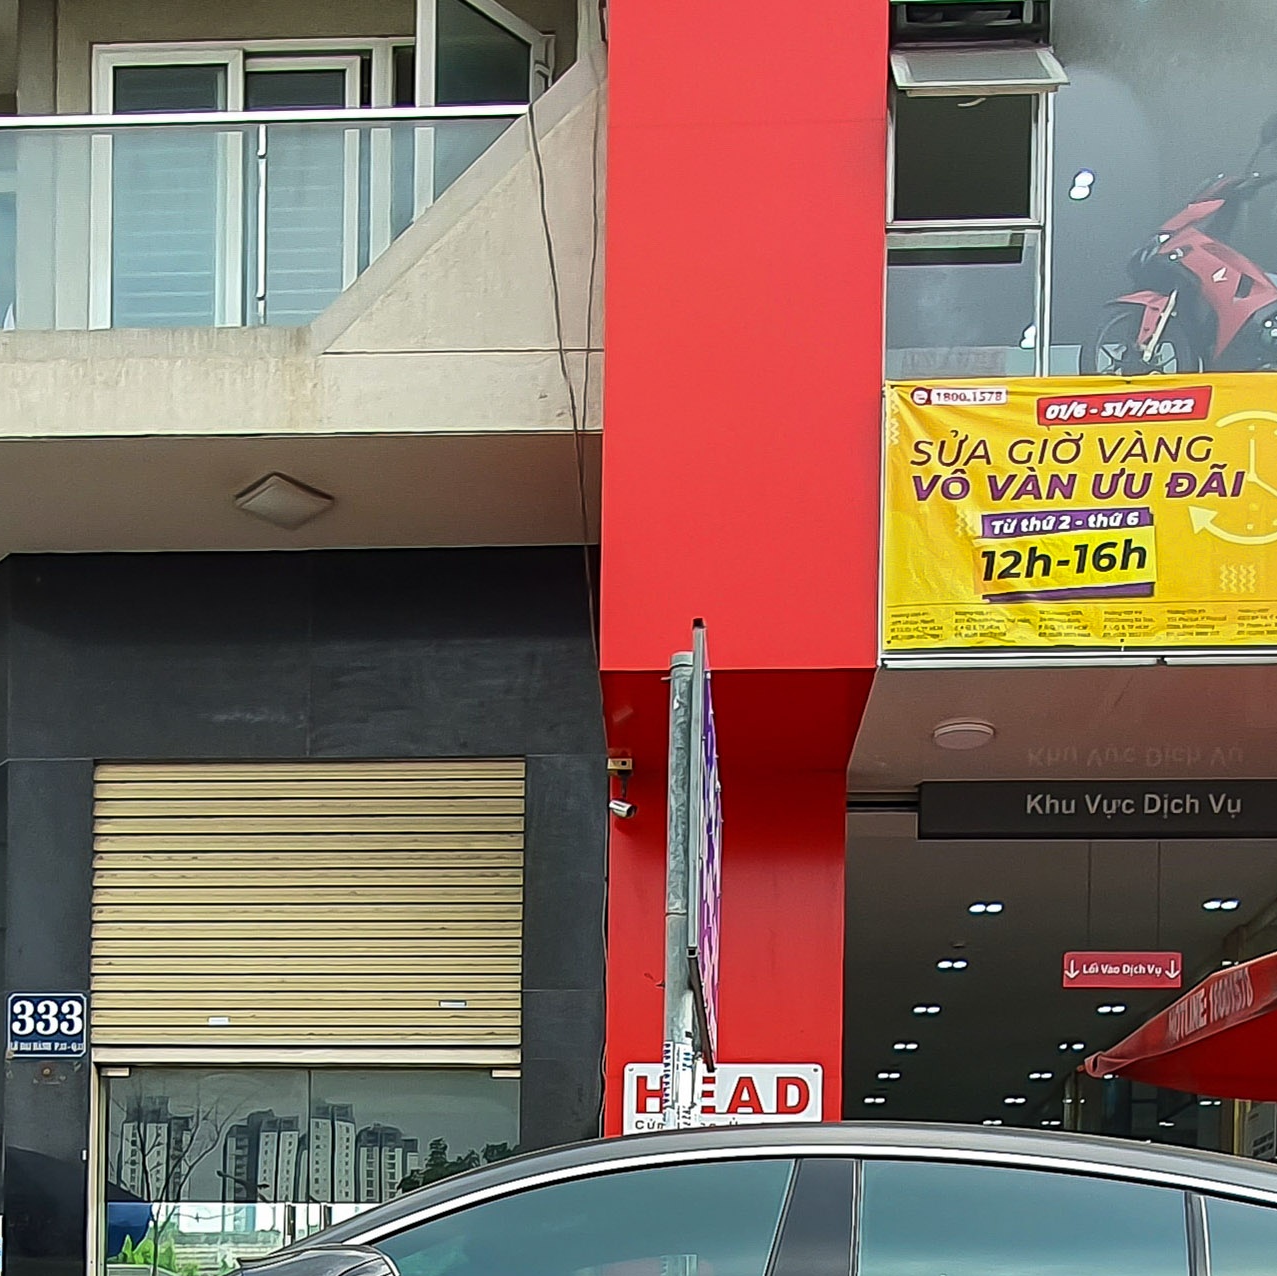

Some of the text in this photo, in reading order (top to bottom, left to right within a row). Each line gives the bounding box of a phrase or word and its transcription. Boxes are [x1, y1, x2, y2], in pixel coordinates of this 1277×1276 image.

[1045, 401, 1084, 420] 01/6
[1102, 398, 1194, 417] 31/7/2022
[910, 430, 1213, 467] SỬA GIỜ VÀNG
[911, 463, 1245, 501] VÔ VÀN ƯU ĐÃI
[991, 517, 1014, 535] Từ
[1021, 514, 1053, 532] thứ
[1056, 516, 1070, 531] 2
[1088, 511, 1122, 528] thứ
[1126, 511, 1139, 527] 6
[981, 539, 1147, 582] 12h-16h
[1026, 793, 1242, 819] Khu Vực Dịch Vụ
[11, 1000, 83, 1035] 333
